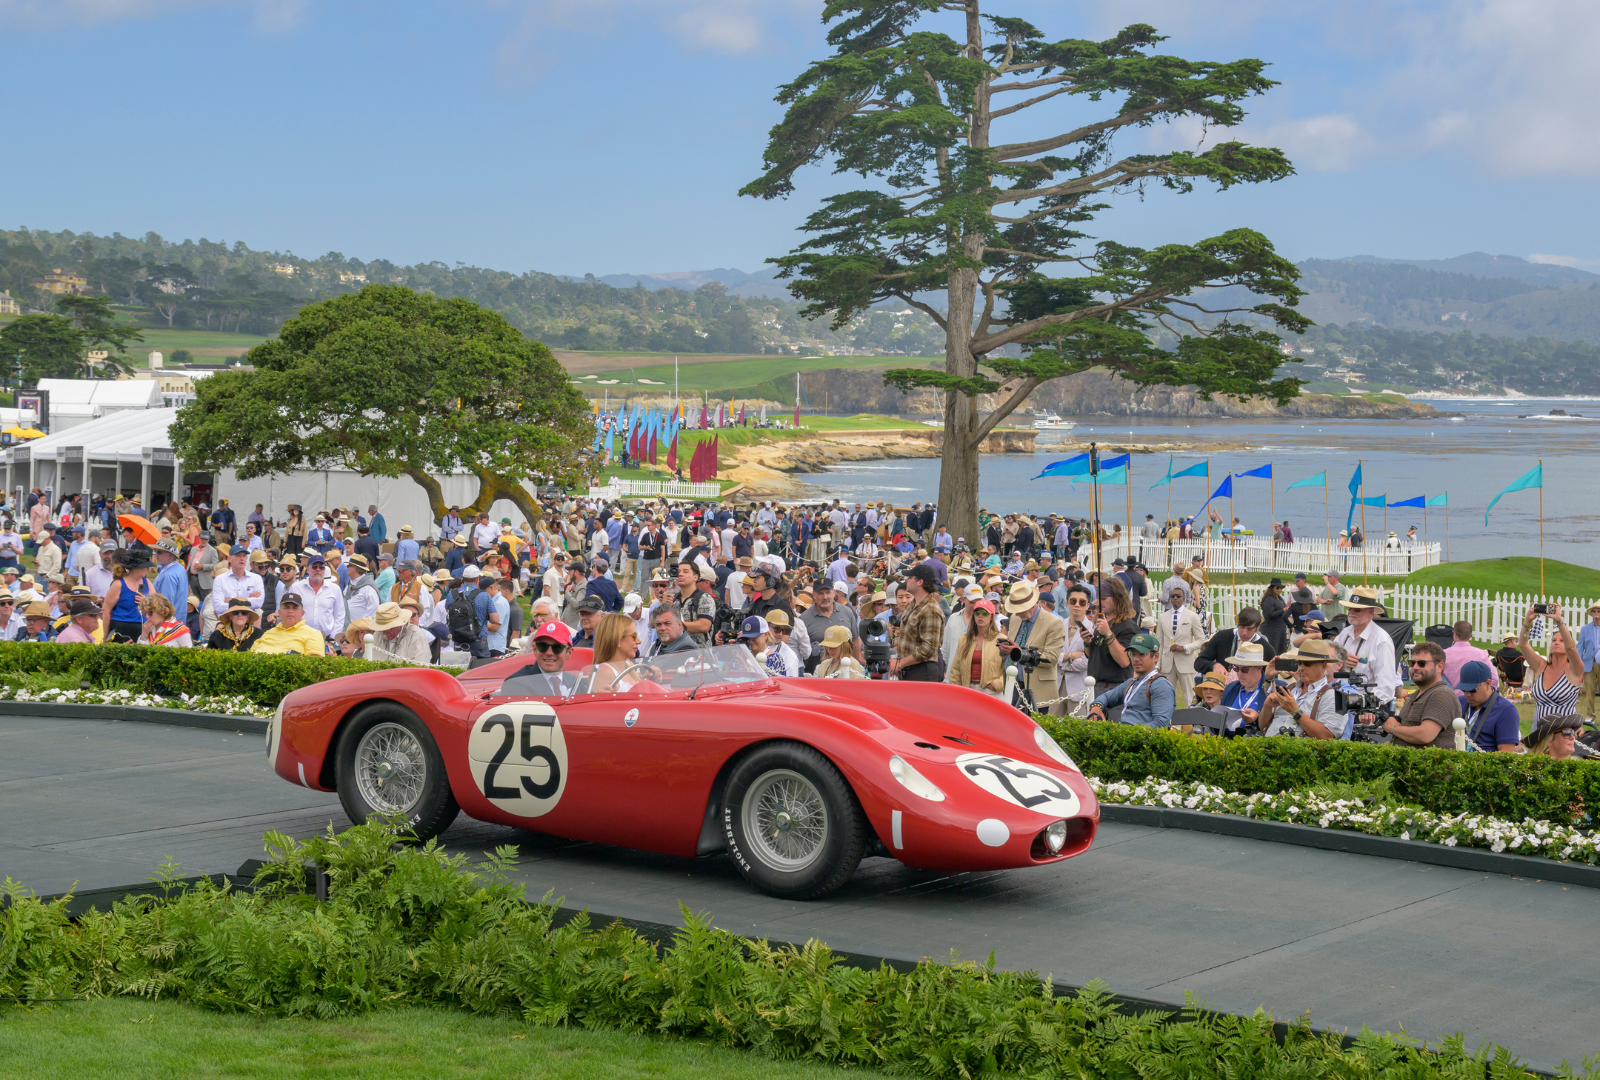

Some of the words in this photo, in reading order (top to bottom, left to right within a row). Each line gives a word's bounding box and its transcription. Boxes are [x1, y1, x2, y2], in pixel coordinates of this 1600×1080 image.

[481, 713, 560, 799] 25
[964, 758, 1071, 808] 25
[724, 807, 751, 872] ENGLEBERT
